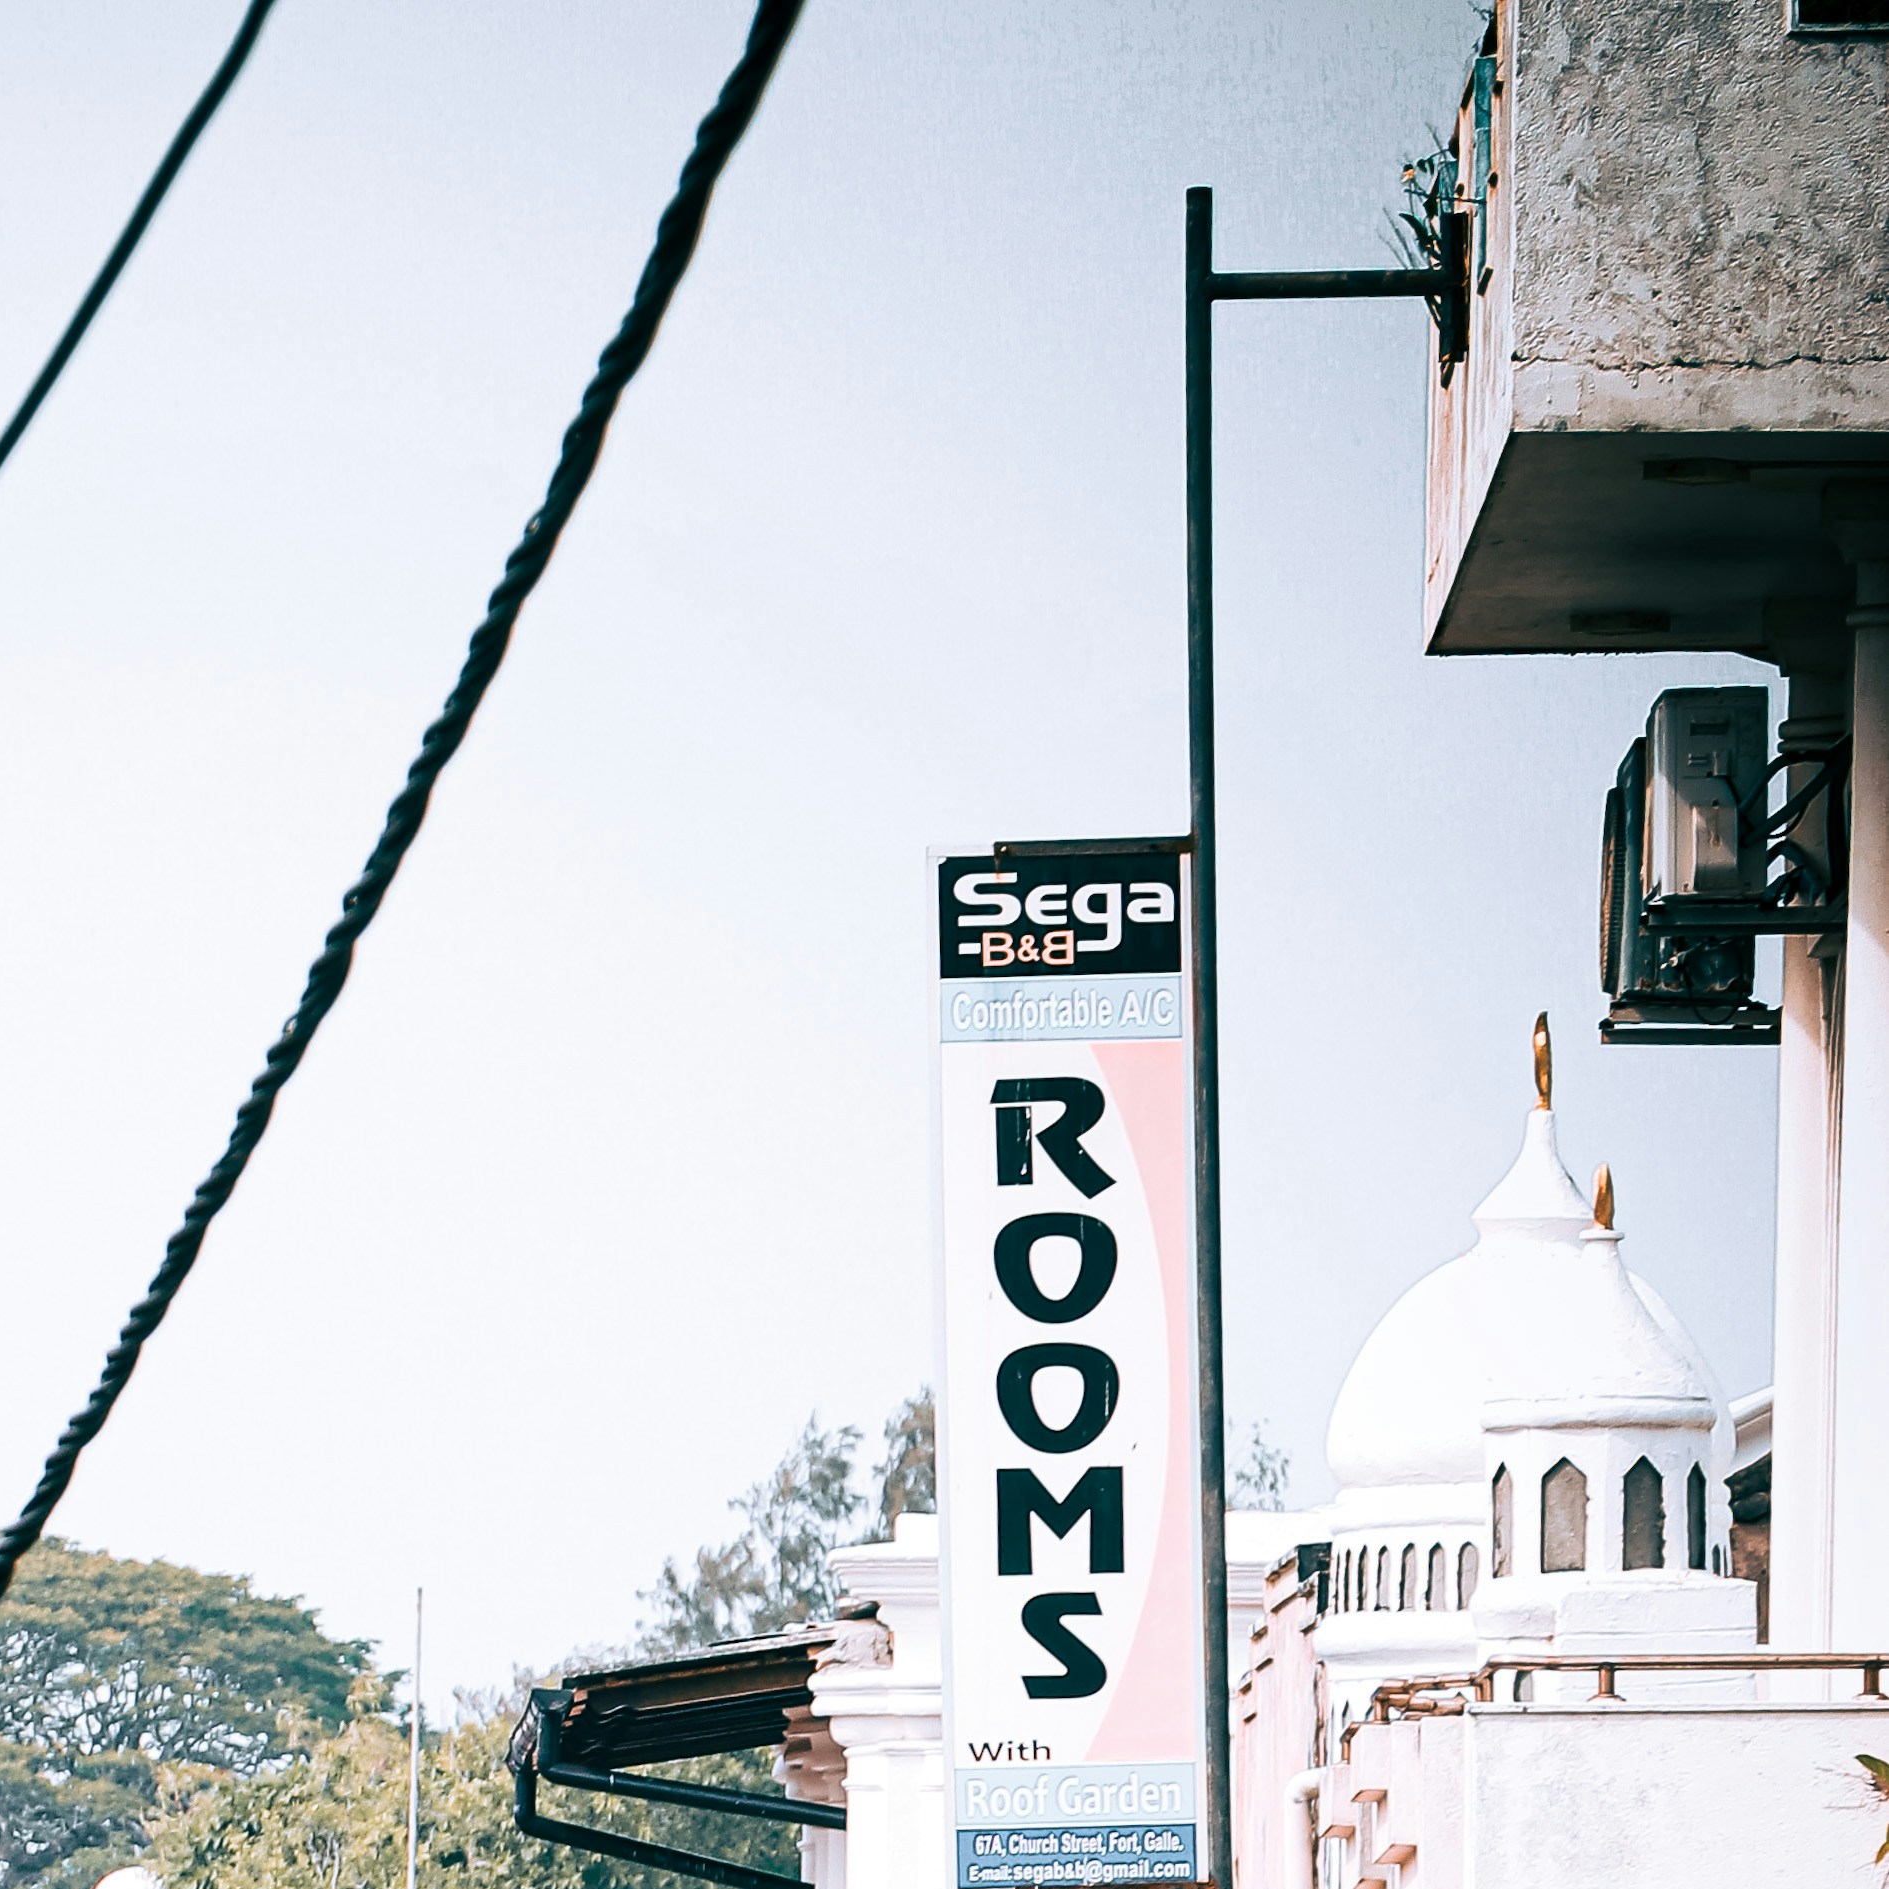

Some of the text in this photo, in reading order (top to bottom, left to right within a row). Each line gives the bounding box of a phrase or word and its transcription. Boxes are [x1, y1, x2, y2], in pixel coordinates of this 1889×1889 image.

[953, 872, 1175, 953] Sega
[952, 988, 1175, 1031] Comfortable A/C
[990, 1076, 1124, 1699] ROOMS
[968, 1740, 1051, 1762] With
[966, 1772, 1181, 1818] Roof Garden
[975, 1834, 1007, 1858] 67A,
[1009, 1833, 1059, 1854] Church
[1061, 1831, 1106, 1856] Street,
[1109, 1831, 1142, 1855] Fort,
